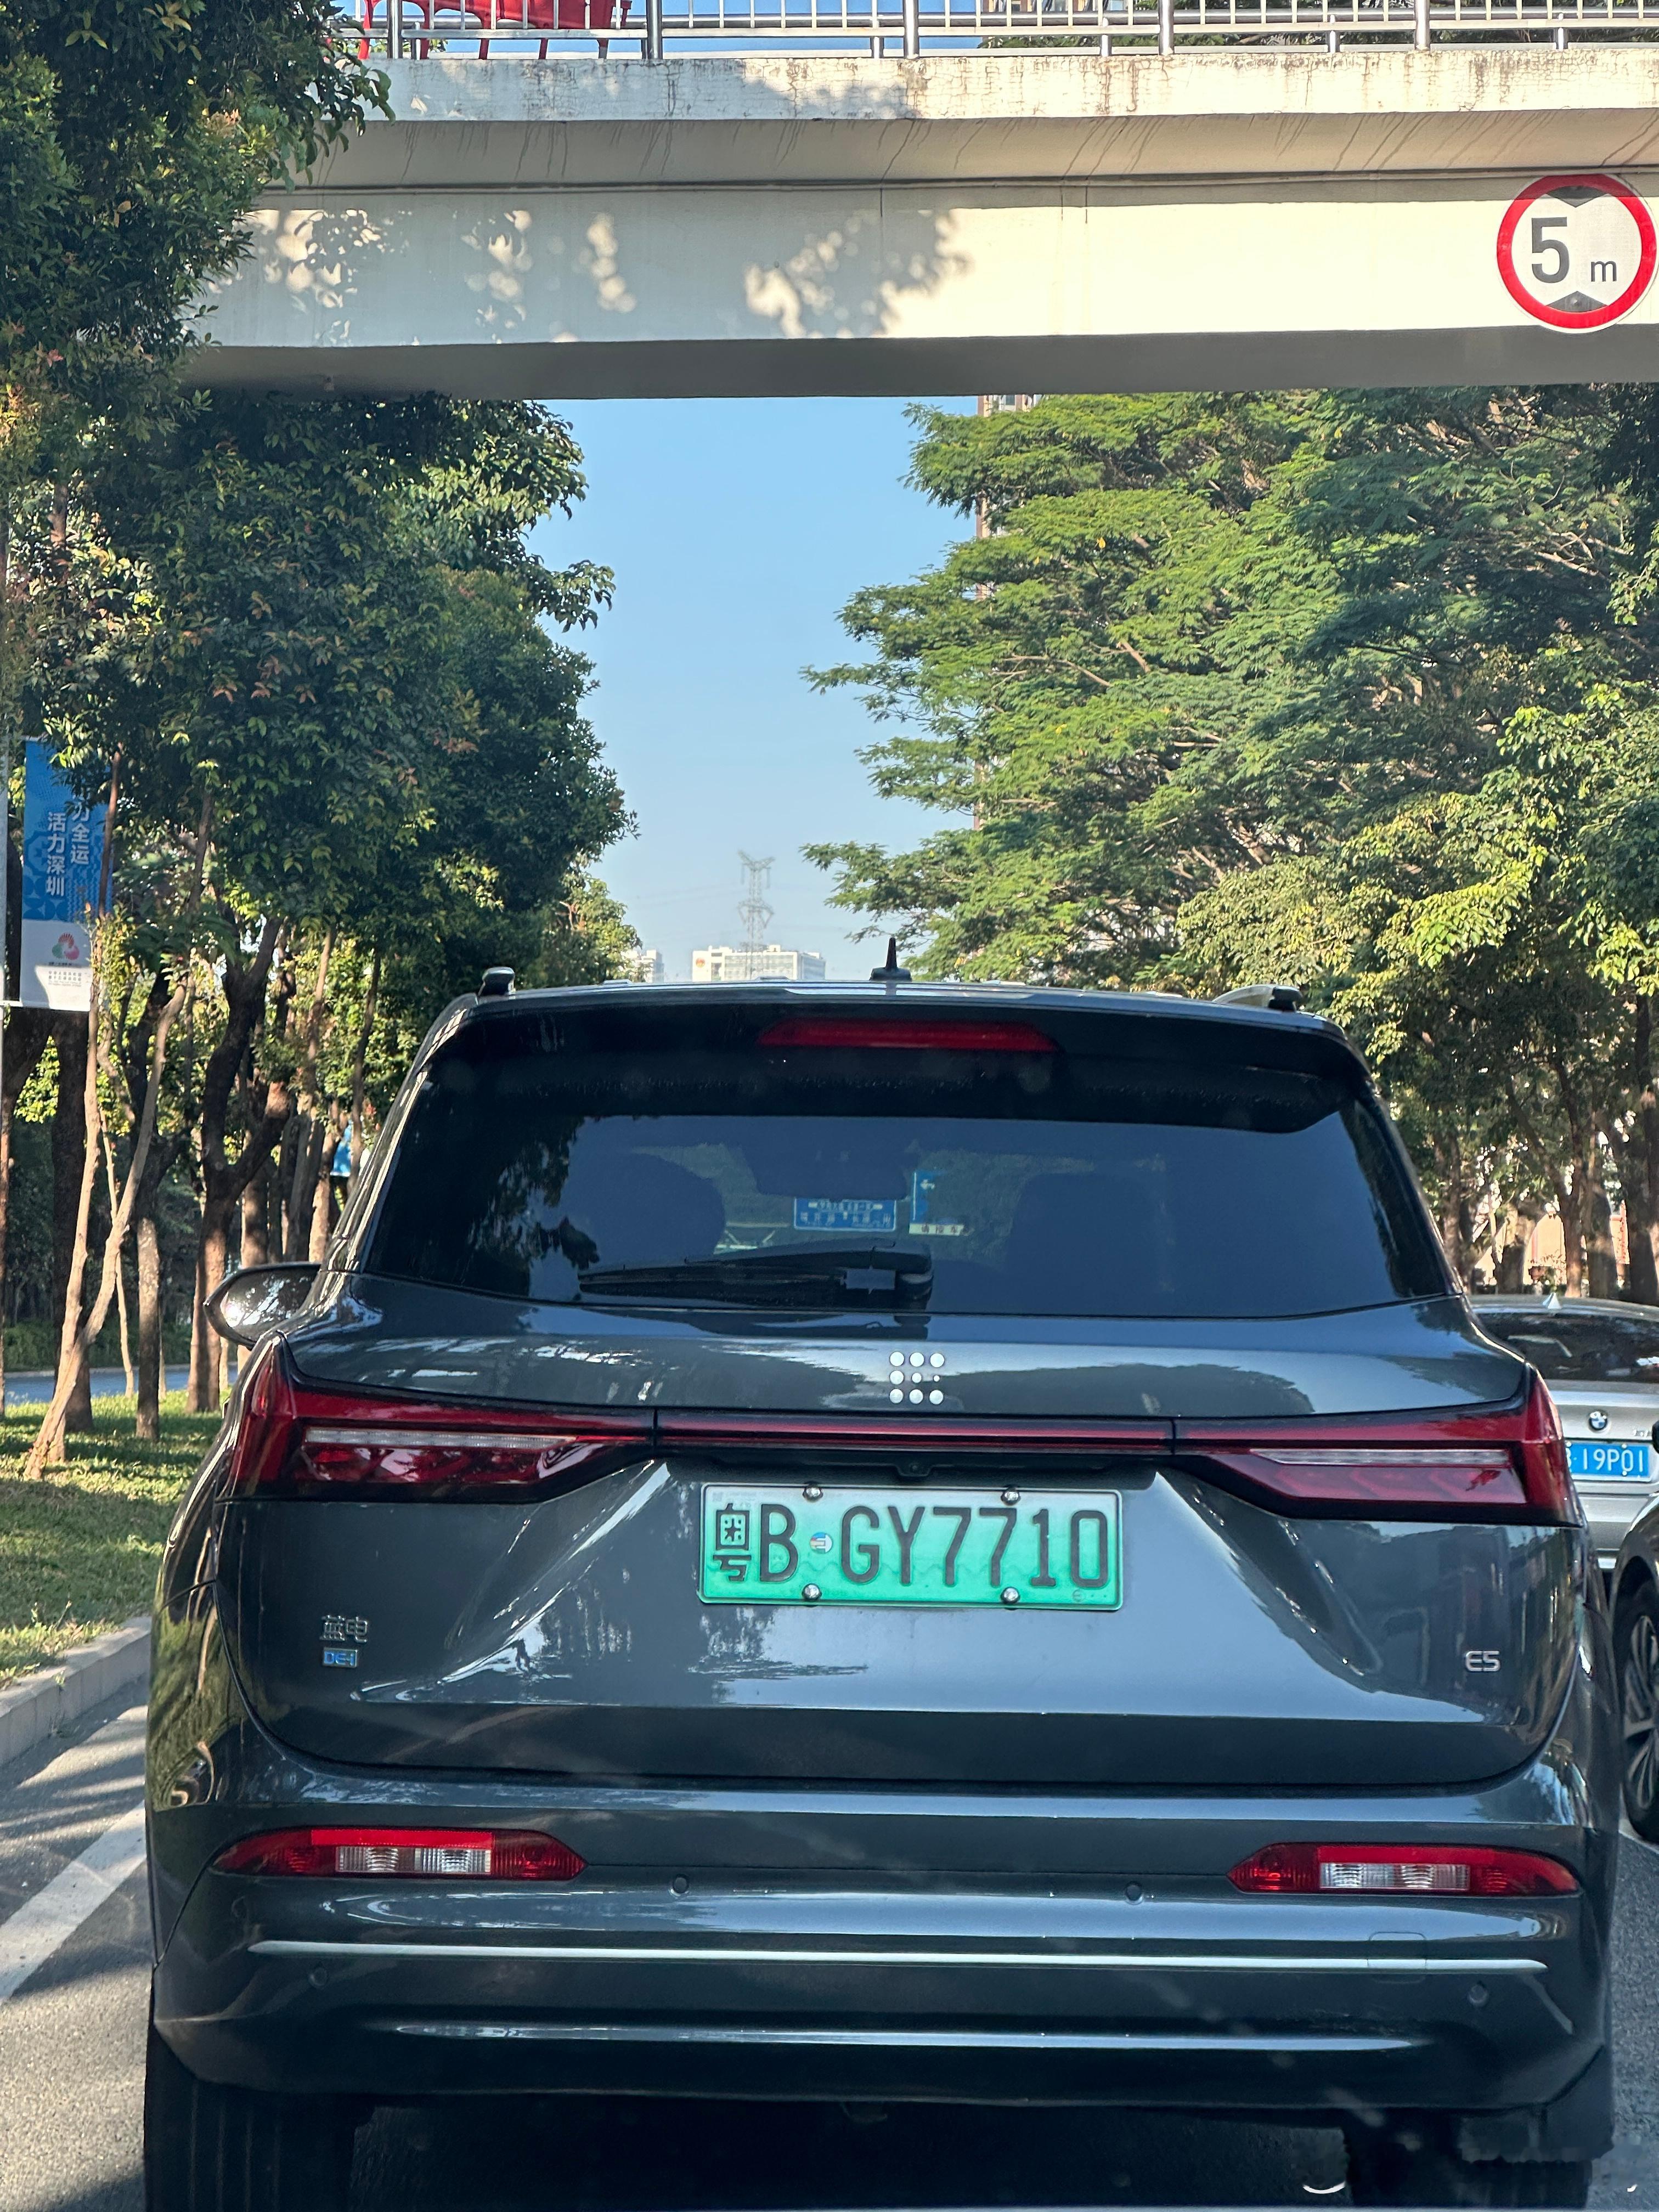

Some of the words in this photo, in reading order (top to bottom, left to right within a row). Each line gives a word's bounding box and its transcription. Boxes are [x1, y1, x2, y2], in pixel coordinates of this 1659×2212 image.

[1532, 217, 1570, 283] 5
[1591, 261, 1617, 281] m
[46, 811, 66, 897] 活力深圳
[71, 787, 91, 865] 力全运
[1465, 1651, 1500, 1672] E5
